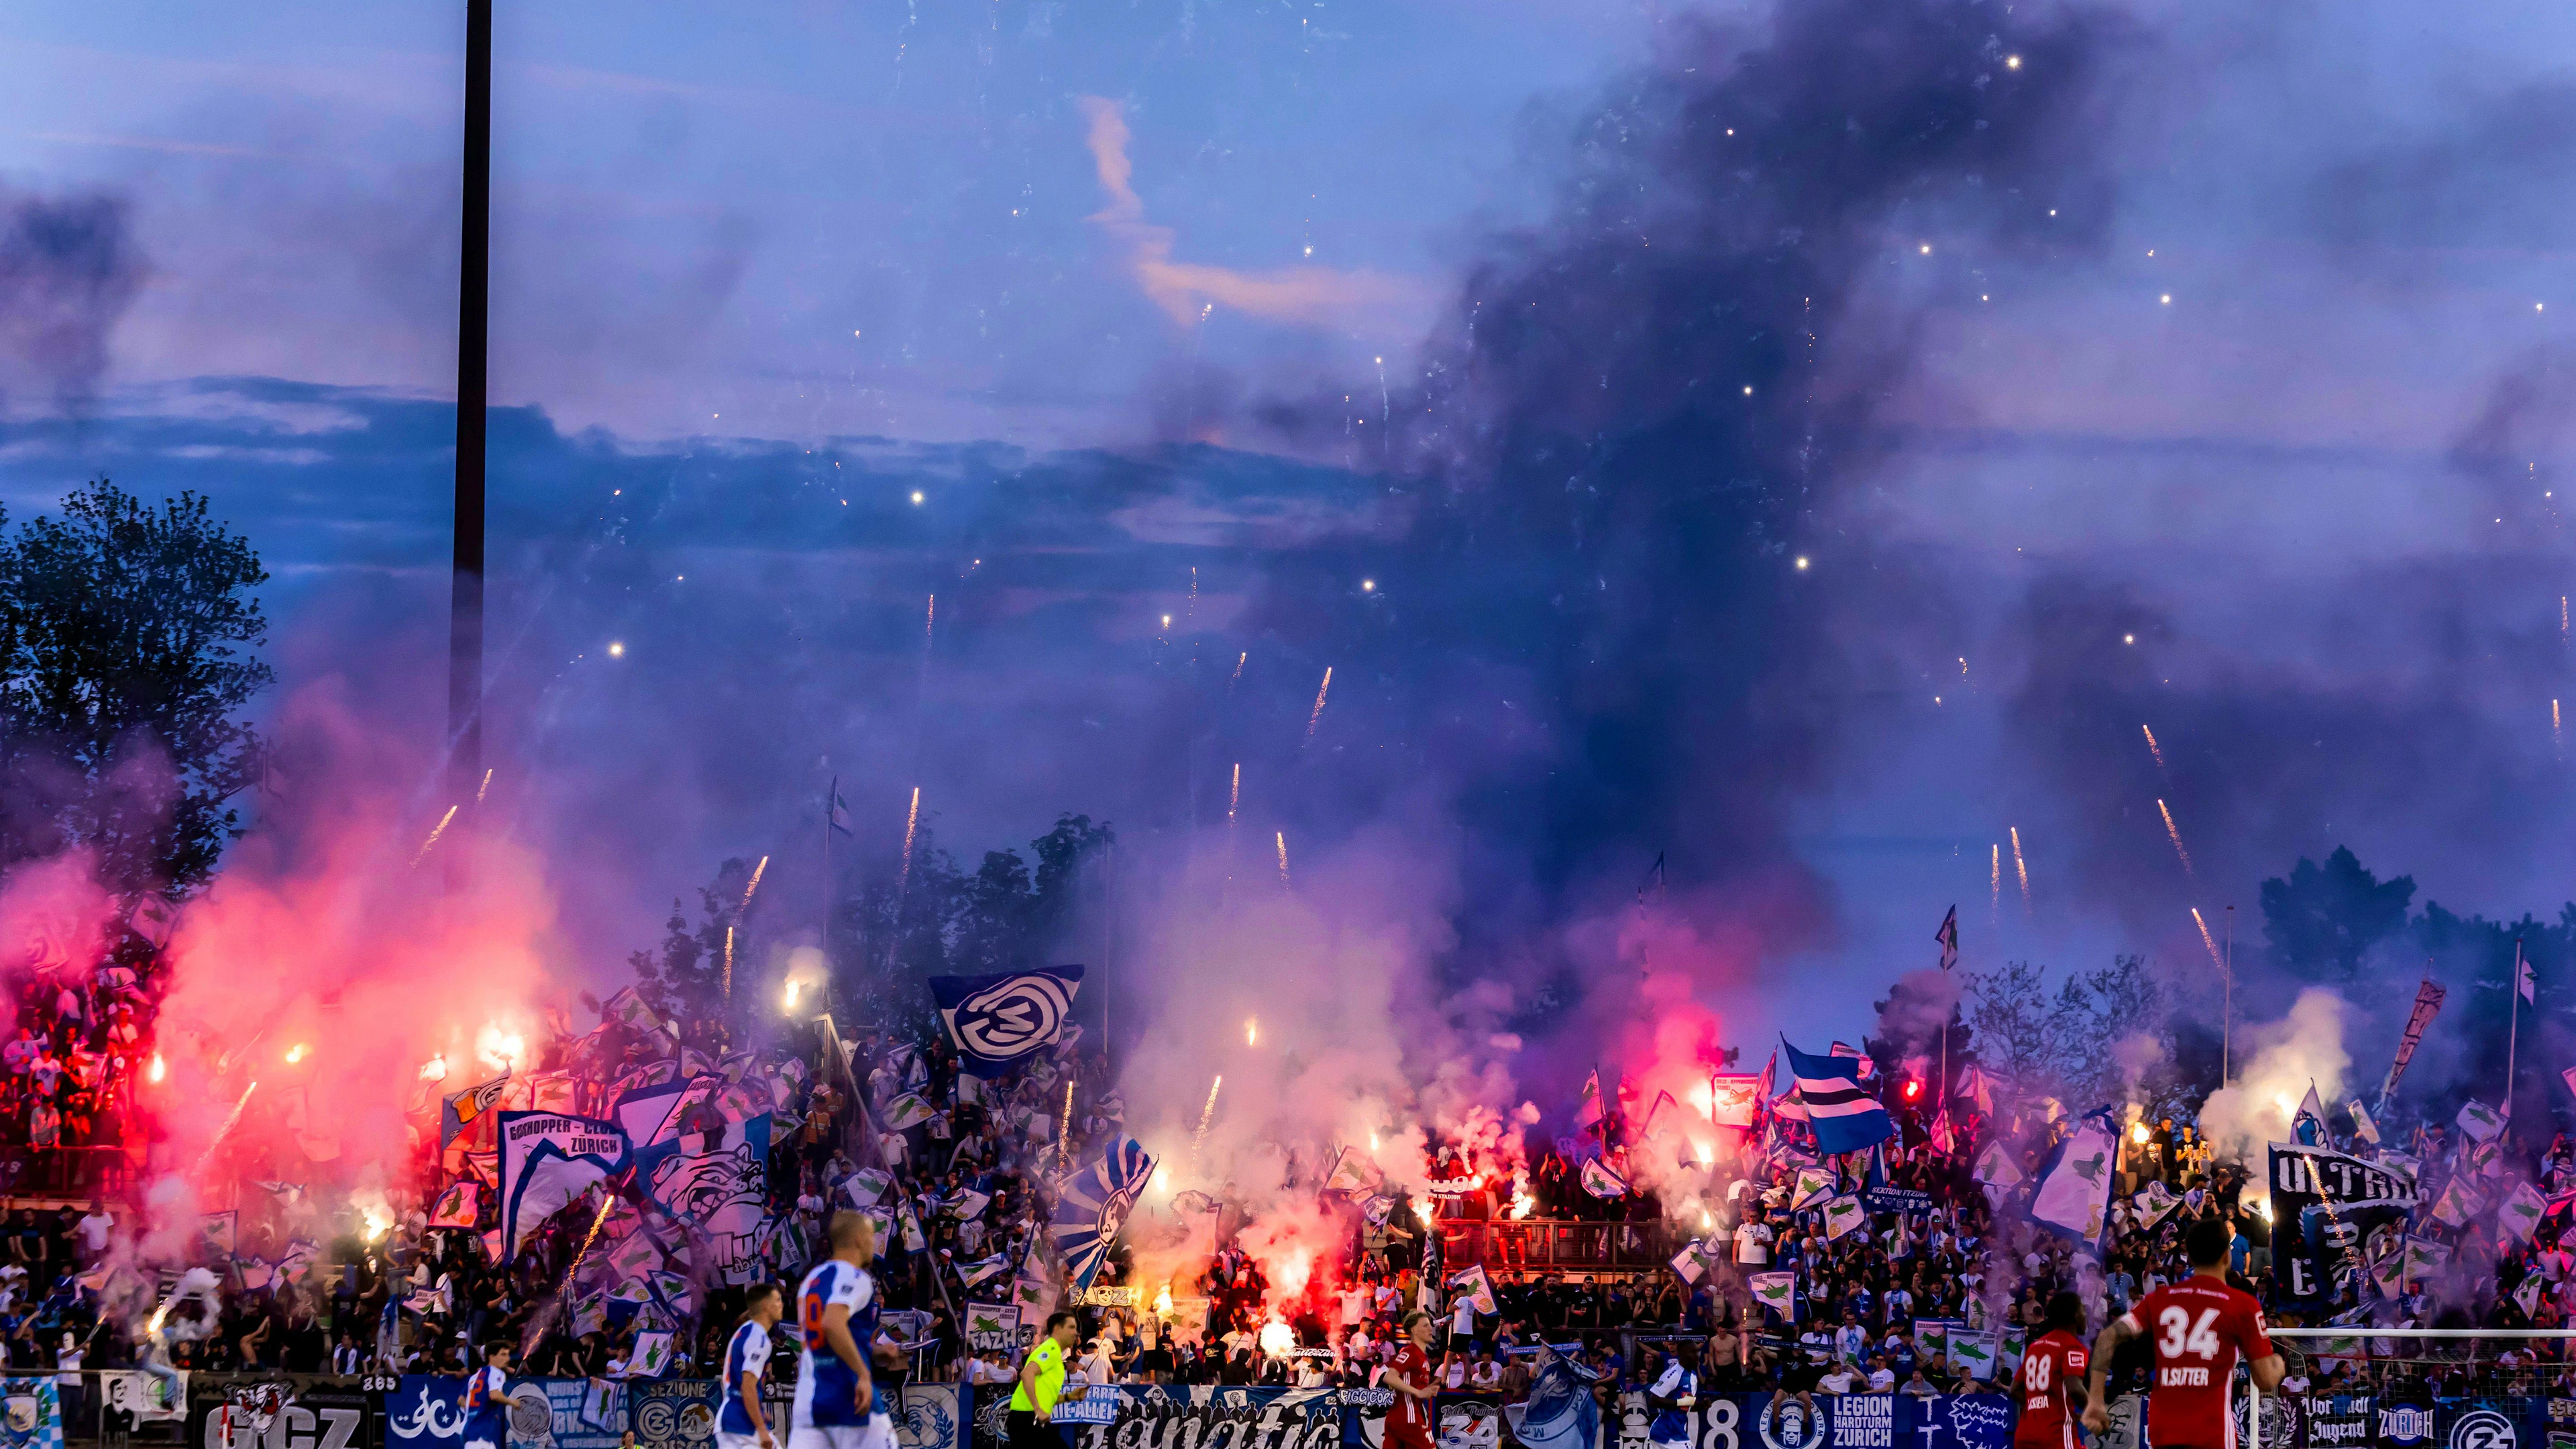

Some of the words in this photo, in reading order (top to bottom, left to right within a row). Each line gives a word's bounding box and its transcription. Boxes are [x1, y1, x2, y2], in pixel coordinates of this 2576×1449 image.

[571, 1134, 617, 1154] ZÜRICH
[2158, 1304, 2221, 1361] 34
[2025, 1353, 2052, 1392] 88
[648, 1382, 707, 1398] SEZIONE
[1833, 1396, 1892, 1416] LEGION
[1833, 1416, 1892, 1429] HARDTURM
[2310, 1419, 2367, 1444] Jugend
[2378, 1408, 2434, 1439] ZÜRICH
[1833, 1429, 1892, 1448] ZURICH
